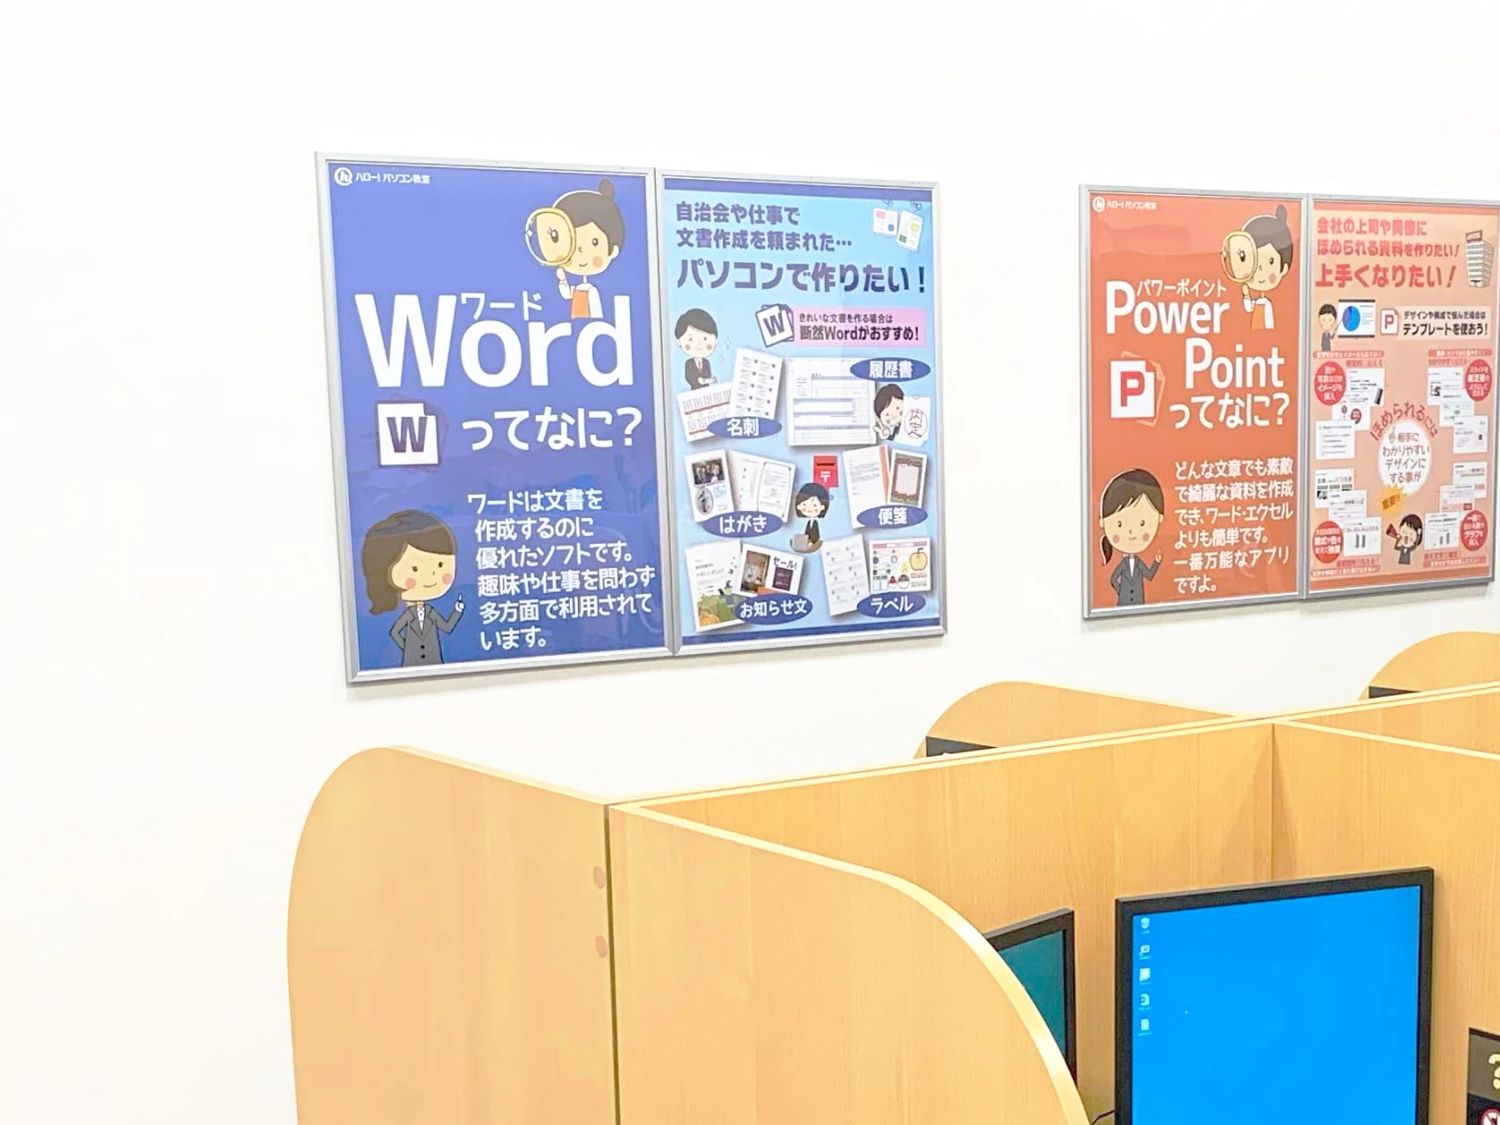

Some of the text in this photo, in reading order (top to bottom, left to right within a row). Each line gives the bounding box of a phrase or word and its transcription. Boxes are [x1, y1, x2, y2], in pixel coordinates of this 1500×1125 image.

[675, 202, 800, 226] 自治会や仕事で
[677, 257, 926, 293] パソコンで作りたい！
[1315, 263, 1457, 288] 上手くなりたい！
[1137, 278, 1227, 298] パワーポイント
[461, 291, 542, 321] ワード
[1106, 280, 1230, 335] Power
[1384, 314, 1395, 329] P
[355, 294, 634, 388] Word
[869, 361, 914, 379] 履歴書
[1185, 337, 1285, 389] Point
[1120, 371, 1145, 407] P
[1169, 392, 1290, 429] ってなに?
[387, 416, 428, 453] W
[462, 406, 643, 451] ってなに?
[727, 418, 759, 436] 名刺
[1175, 457, 1293, 480] どんな文章でも素敵
[1385, 458, 1427, 470] デザインに
[467, 488, 603, 514] ワードは文書を
[1174, 479, 1294, 503] で綺麗な資料を作成
[719, 516, 768, 535] はがき
[878, 508, 908, 525] 便箋
[475, 517, 594, 542] 作成するのに
[1174, 526, 1268, 550] よりも簡単です。
[476, 541, 633, 570] 優れたソフトです。
[1173, 546, 1289, 571] 一番万能なアプリ
[477, 565, 656, 597] 趣味や仕事を問わず
[1174, 576, 1217, 593] ですよ。
[480, 593, 652, 624] 多方面で利用されて
[740, 598, 808, 617] お知らせ文
[870, 597, 914, 614] ラベル
[481, 625, 547, 650] います。
